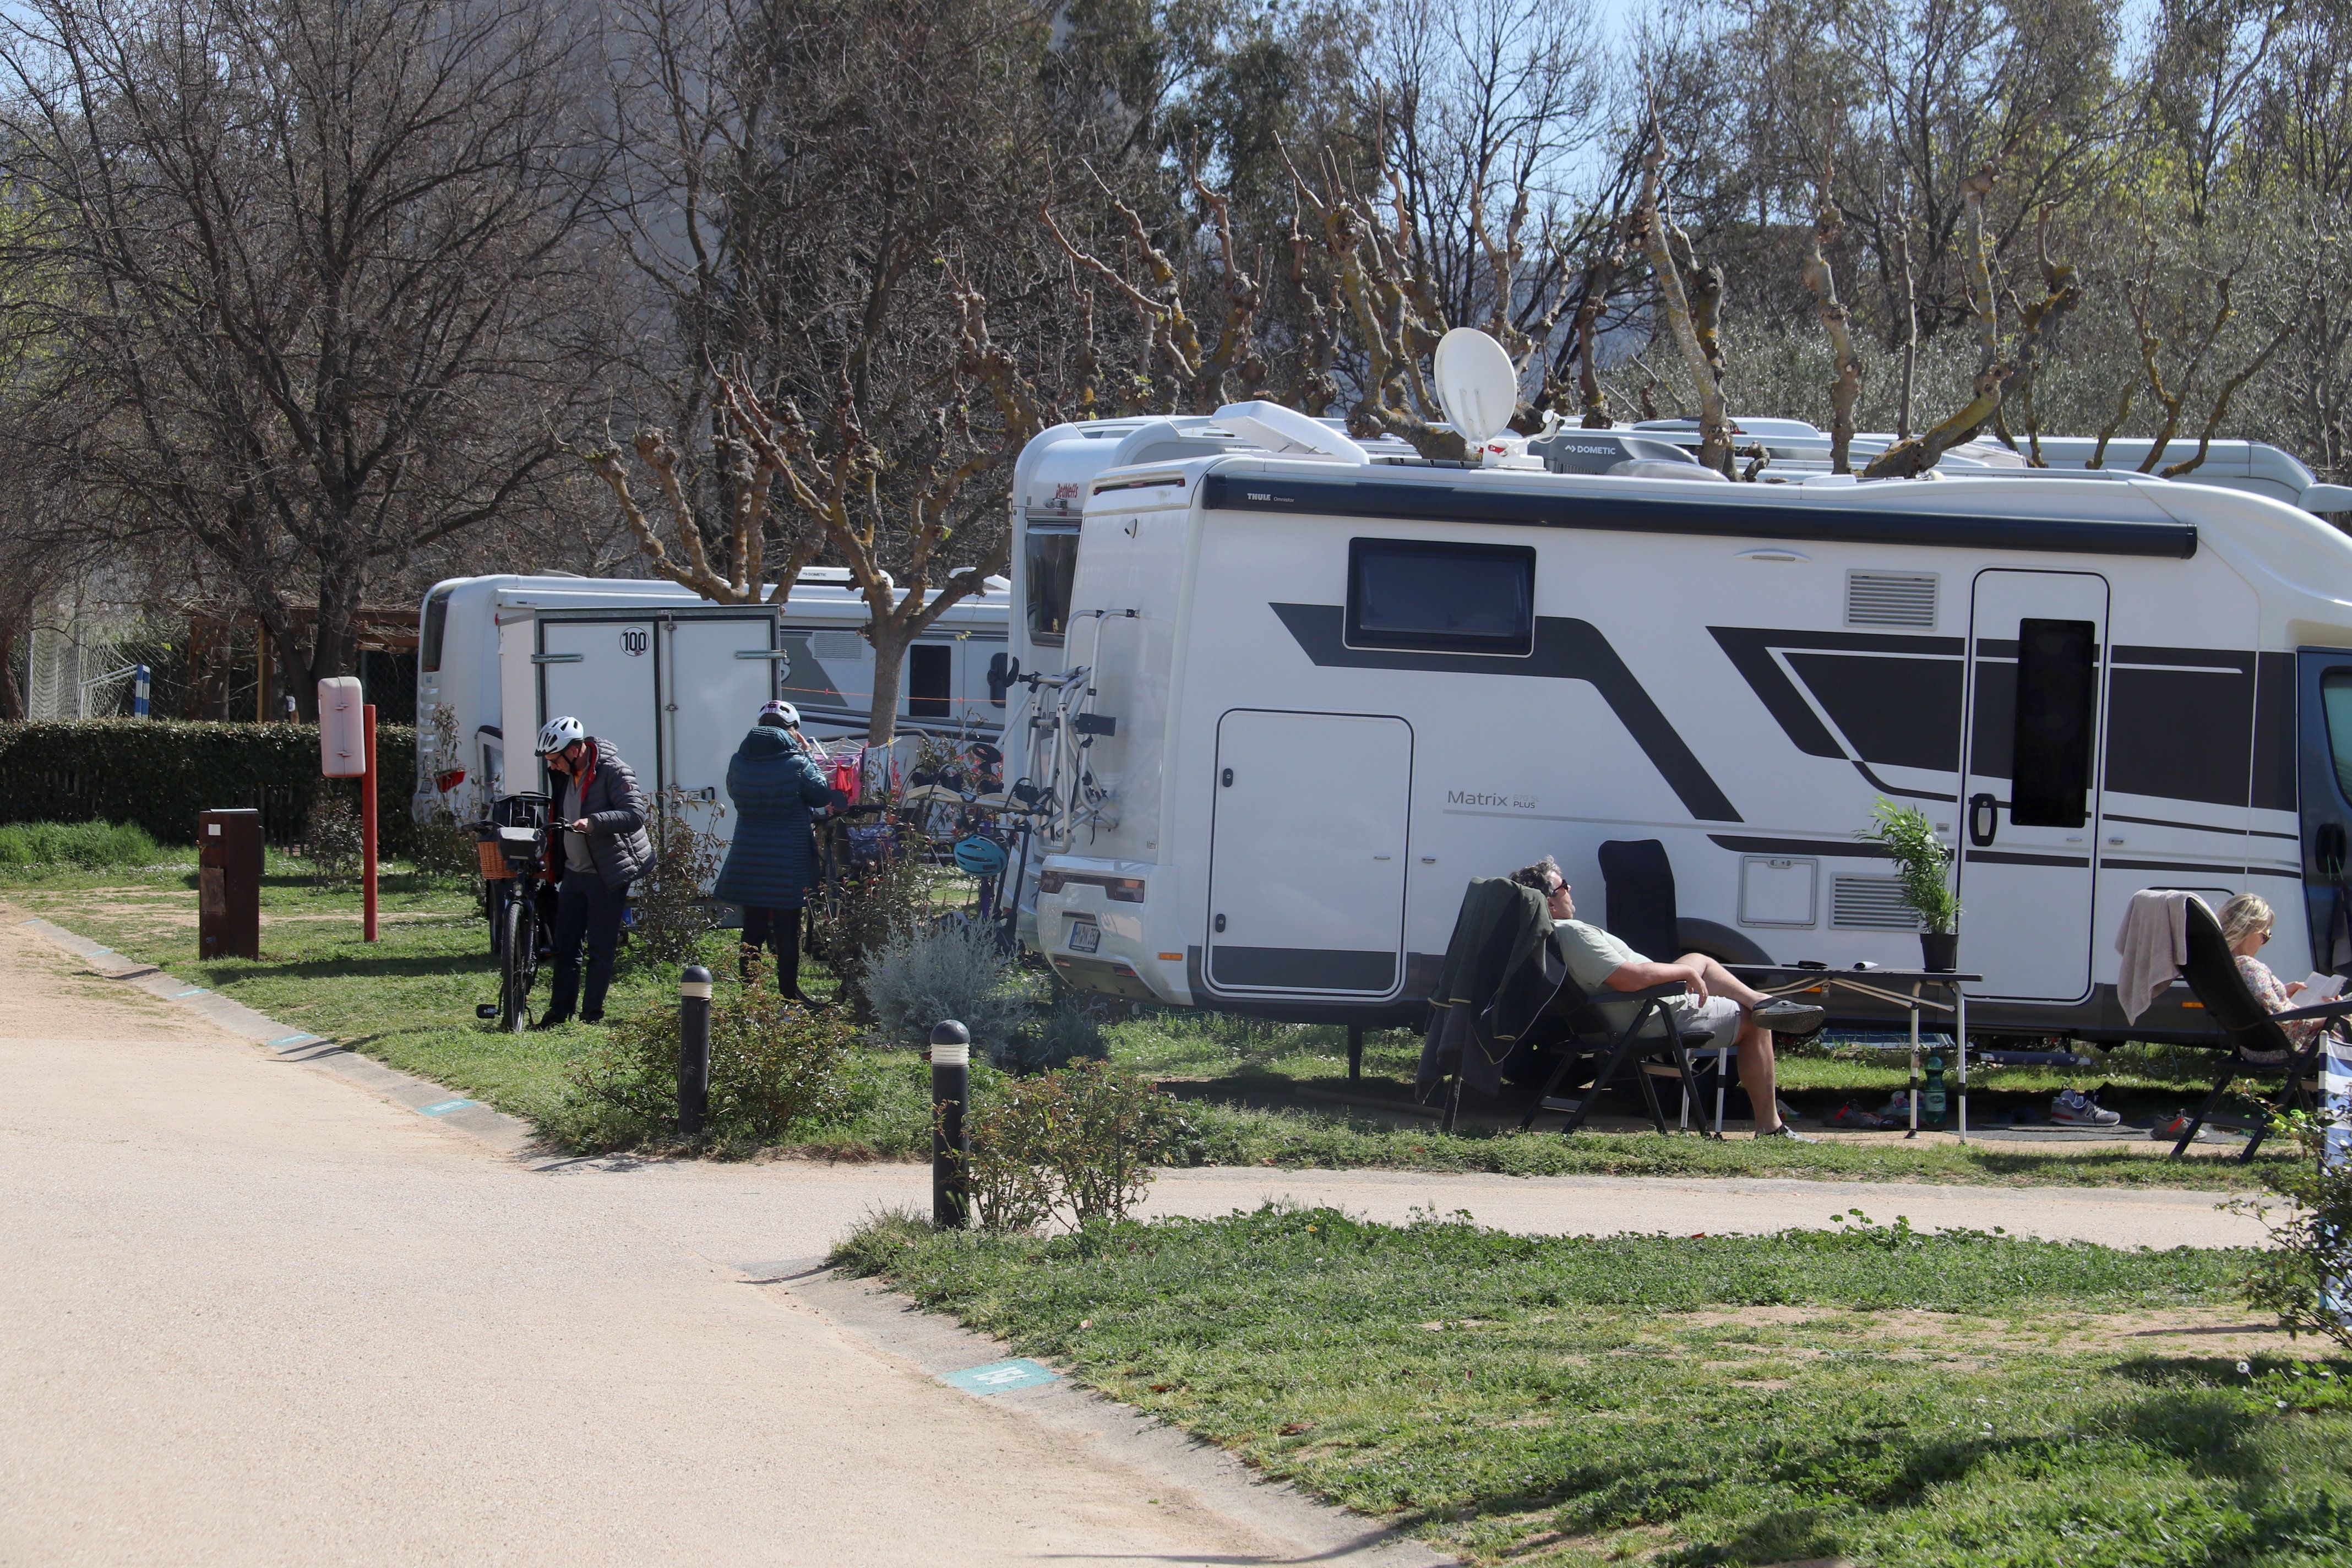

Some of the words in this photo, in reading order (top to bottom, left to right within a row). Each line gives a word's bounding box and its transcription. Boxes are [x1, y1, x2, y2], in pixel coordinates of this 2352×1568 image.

[1577, 445, 1616, 455] DOMETIC
[1247, 493, 1271, 501] THULE
[623, 631, 646, 651] 100
[1447, 790, 1508, 807] Matrix
